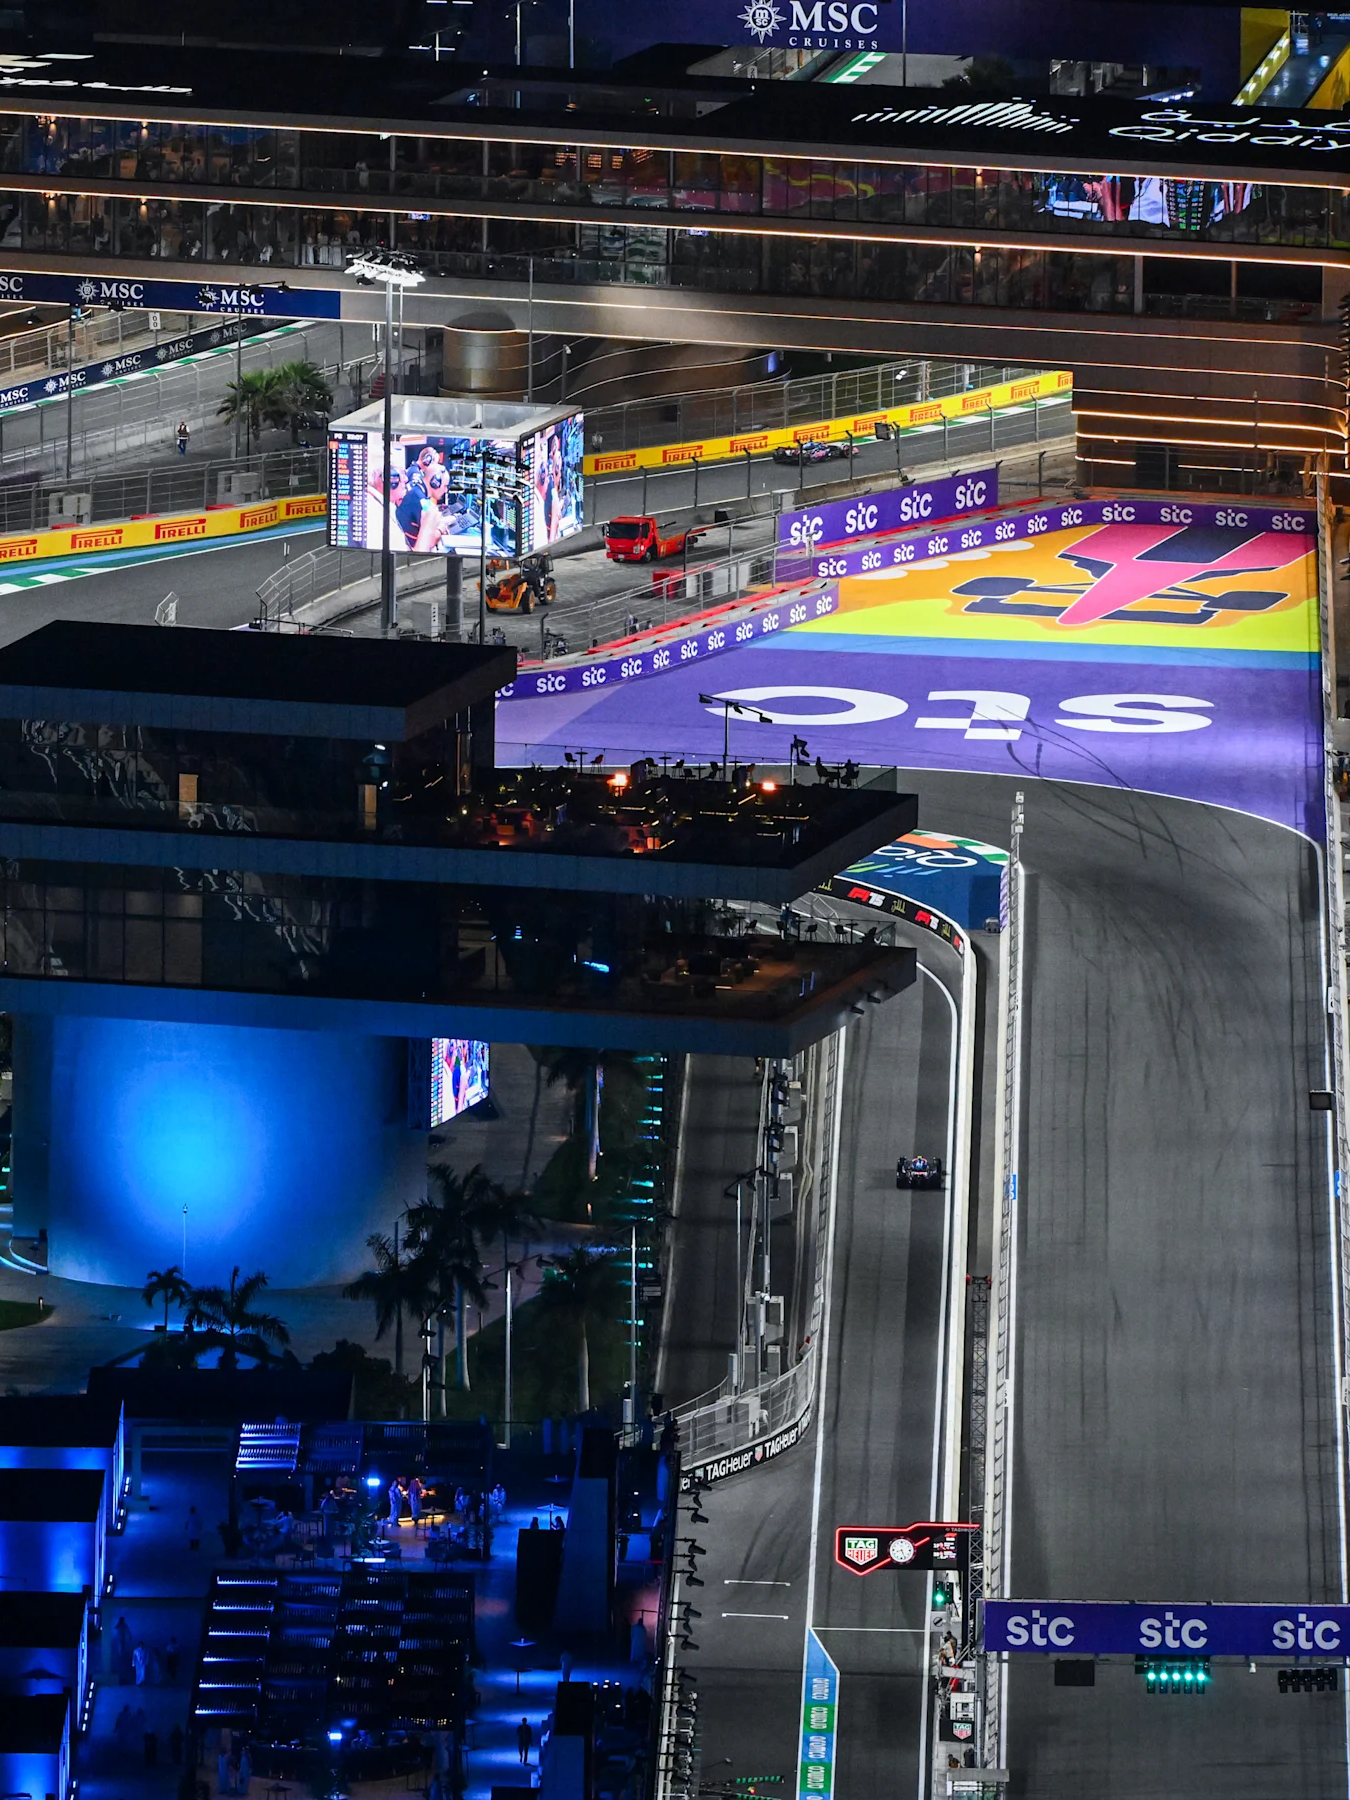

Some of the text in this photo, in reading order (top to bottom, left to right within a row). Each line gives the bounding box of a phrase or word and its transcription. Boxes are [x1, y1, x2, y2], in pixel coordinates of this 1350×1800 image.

[789, 0, 878, 34] MSC
[789, 37, 878, 49] CRUISES
[1108, 125, 1350, 150] Qiddiy
[100, 282, 144, 299] MSC
[221, 288, 264, 306] MSC
[168, 339, 194, 356] MSC
[115, 355, 142, 371] MSC
[58, 371, 87, 388] MSC
[1058, 371, 1073, 388] PIRE
[0, 387, 29, 403] MSC
[1010, 381, 1040, 399] PIRELLI
[962, 392, 992, 410] PIRELLI
[909, 403, 942, 422] PIRELLI
[793, 425, 830, 443] PIRELLI
[853, 415, 888, 433] PIRE
[662, 444, 703, 463] PIRELLI
[730, 435, 768, 453] PIRELLI
[593, 454, 637, 472] PIRELLI
[955, 478, 987, 509] stc
[900, 490, 933, 521] stc
[1102, 503, 1135, 522] stc
[1160, 505, 1193, 524] stc
[240, 505, 278, 528] PIRELLI
[845, 502, 878, 533] stc
[1027, 514, 1048, 534] stc
[1061, 507, 1083, 527] stc
[1215, 509, 1248, 528] stc
[1271, 512, 1305, 531] stc
[71, 528, 123, 549] PIRELLI
[155, 518, 207, 539] PIRELLI
[790, 515, 823, 546] stc
[995, 521, 1016, 541] stc
[928, 536, 949, 555] stc
[961, 529, 982, 549] stc
[861, 551, 882, 570] stc
[893, 543, 915, 563] stc
[818, 558, 847, 577] stc
[789, 604, 807, 624] stc
[816, 595, 833, 615] stc
[736, 621, 753, 642] stc
[762, 612, 779, 633] stc
[680, 640, 698, 660] stc
[707, 630, 725, 651] stc
[621, 657, 642, 678] stc
[653, 649, 670, 669] stc
[536, 674, 566, 693] stc
[582, 667, 606, 687] stc
[495, 680, 514, 698] tc
[700, 686, 1215, 741] stc
[848, 1540, 876, 1549] TAG
[847, 1550, 876, 1565] HEUER
[1006, 1609, 1075, 1647] stc
[1139, 1611, 1208, 1648] stc
[1272, 1613, 1341, 1650] stc
[810, 1706, 828, 1729] aramco
[807, 1765, 825, 1789] aramco
